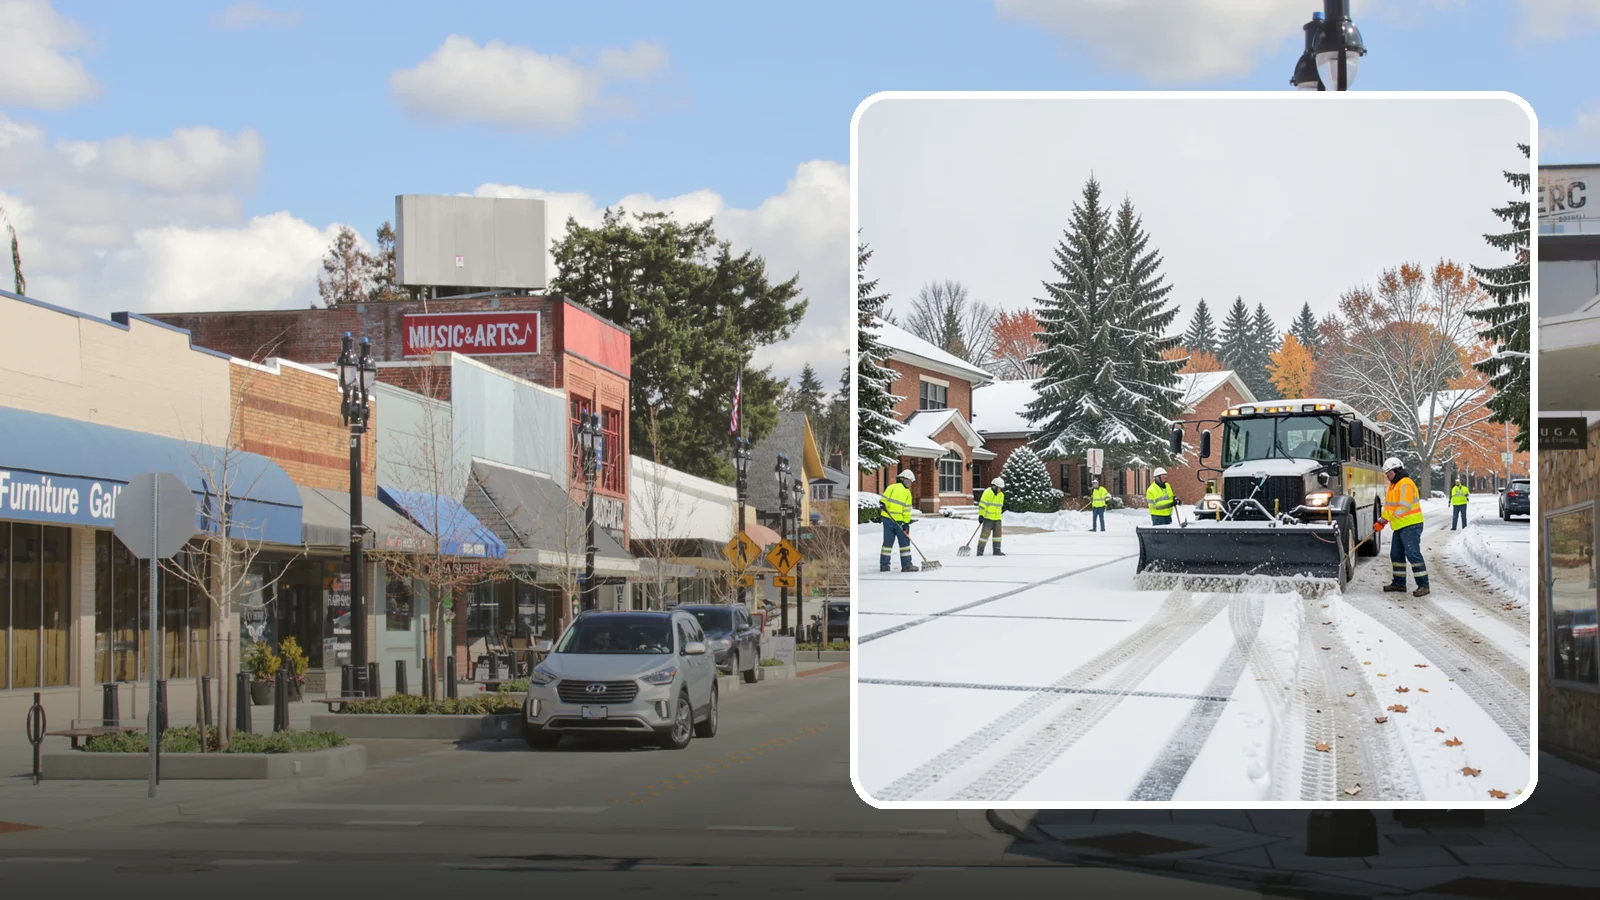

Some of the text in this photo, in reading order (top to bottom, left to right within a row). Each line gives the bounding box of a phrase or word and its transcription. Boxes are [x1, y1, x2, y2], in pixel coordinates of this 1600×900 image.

[408, 323, 519, 349] MUSIC&ARTS
[0, 471, 79, 515] Furniture
[453, 563, 480, 574] SUSHI
